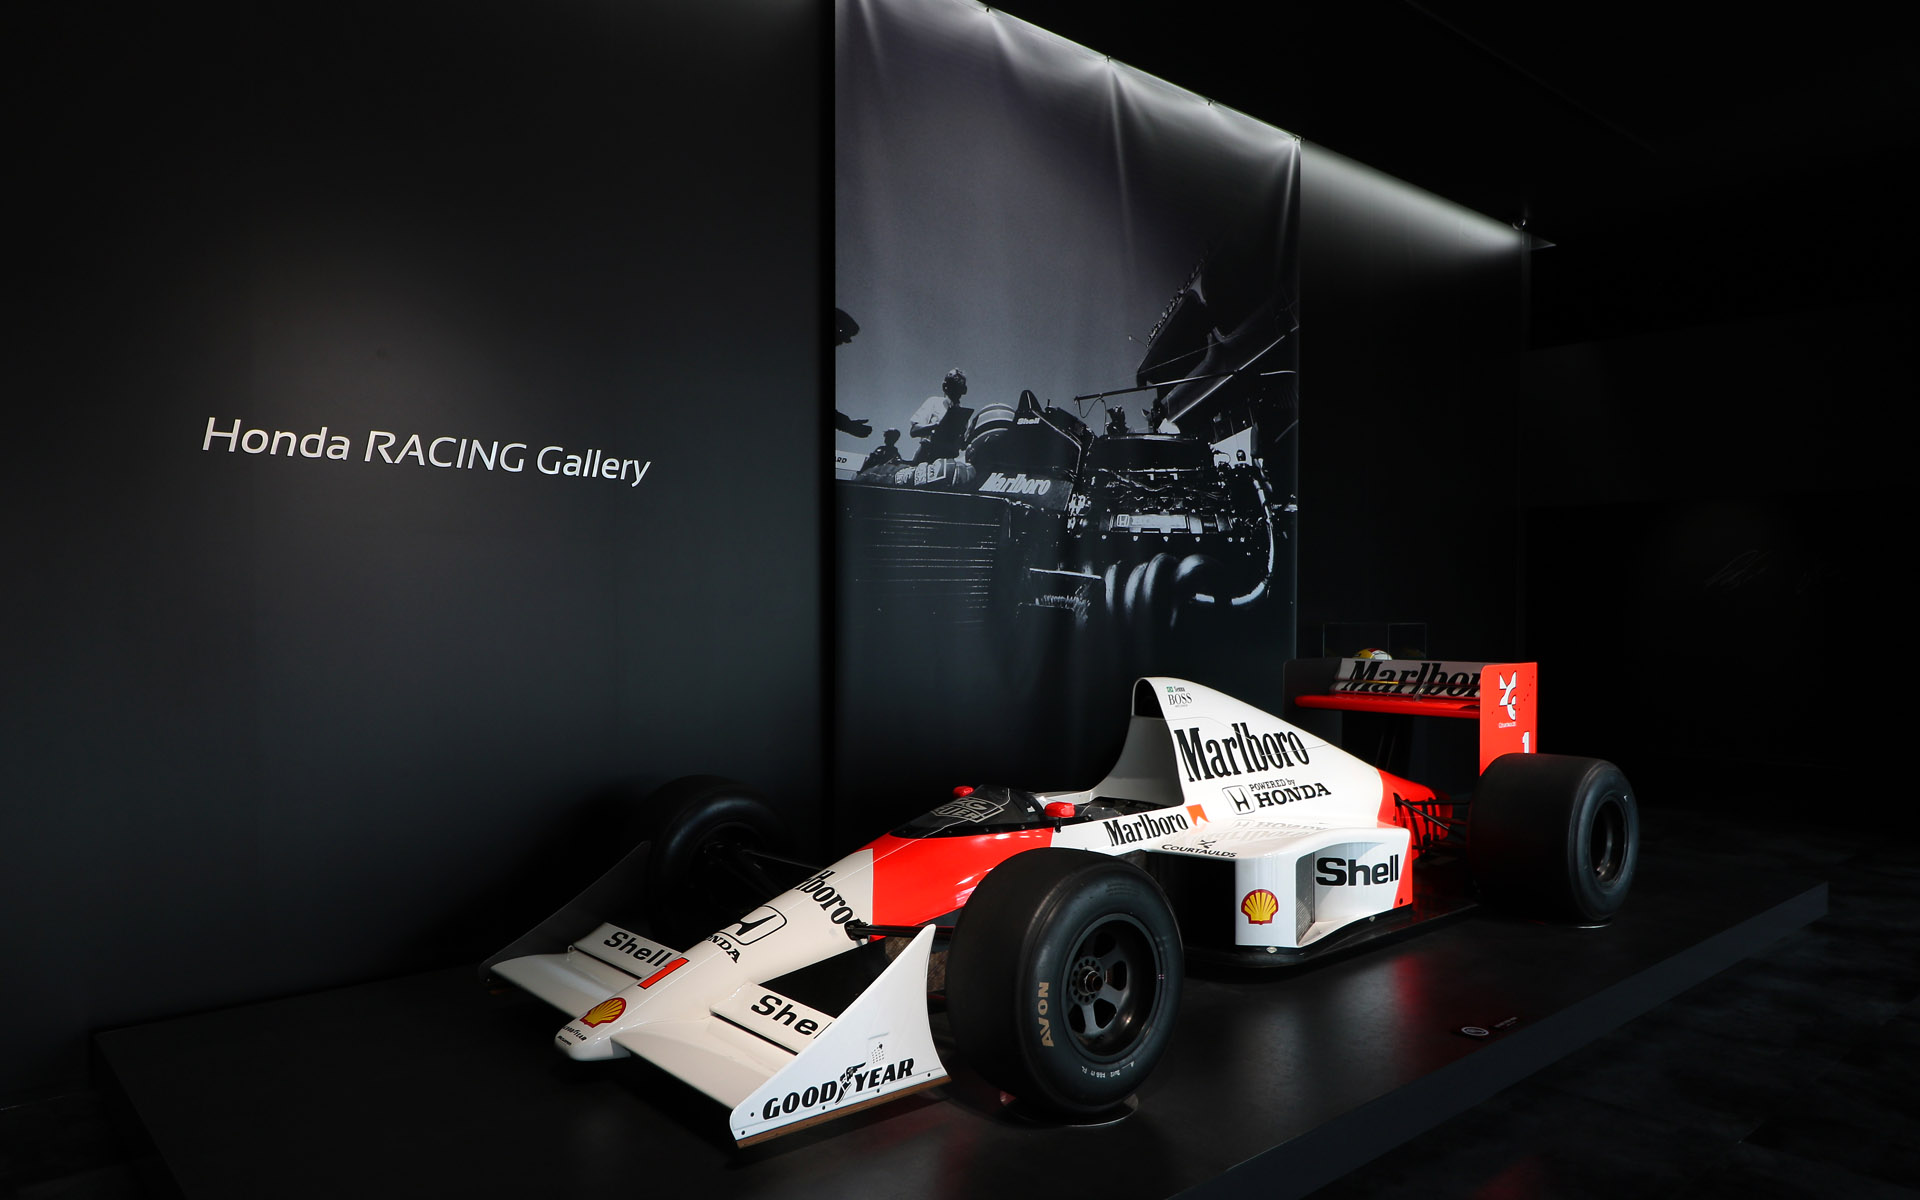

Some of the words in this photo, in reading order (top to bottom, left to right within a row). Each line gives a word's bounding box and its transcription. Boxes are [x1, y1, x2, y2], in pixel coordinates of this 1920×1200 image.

[202, 416, 351, 461] Honda
[363, 430, 527, 473] RACING
[536, 445, 651, 488] Gallery
[978, 472, 1052, 496] Marlboro
[1340, 660, 1481, 698] Marlbor
[1168, 692, 1193, 706] BOSS
[1174, 722, 1310, 782] Marlboro
[1248, 779, 1287, 792] POWERED
[1285, 778, 1296, 787] by
[1254, 782, 1332, 808] HONDA
[1102, 813, 1189, 847] Marlboro
[1161, 843, 1238, 858] COURTAULDS
[1315, 854, 1399, 887] Shell
[795, 870, 854, 925] lboro
[603, 931, 673, 968] Shell
[708, 935, 741, 963] NDA
[750, 994, 833, 1040] She
[1038, 981, 1055, 1048] AVON
